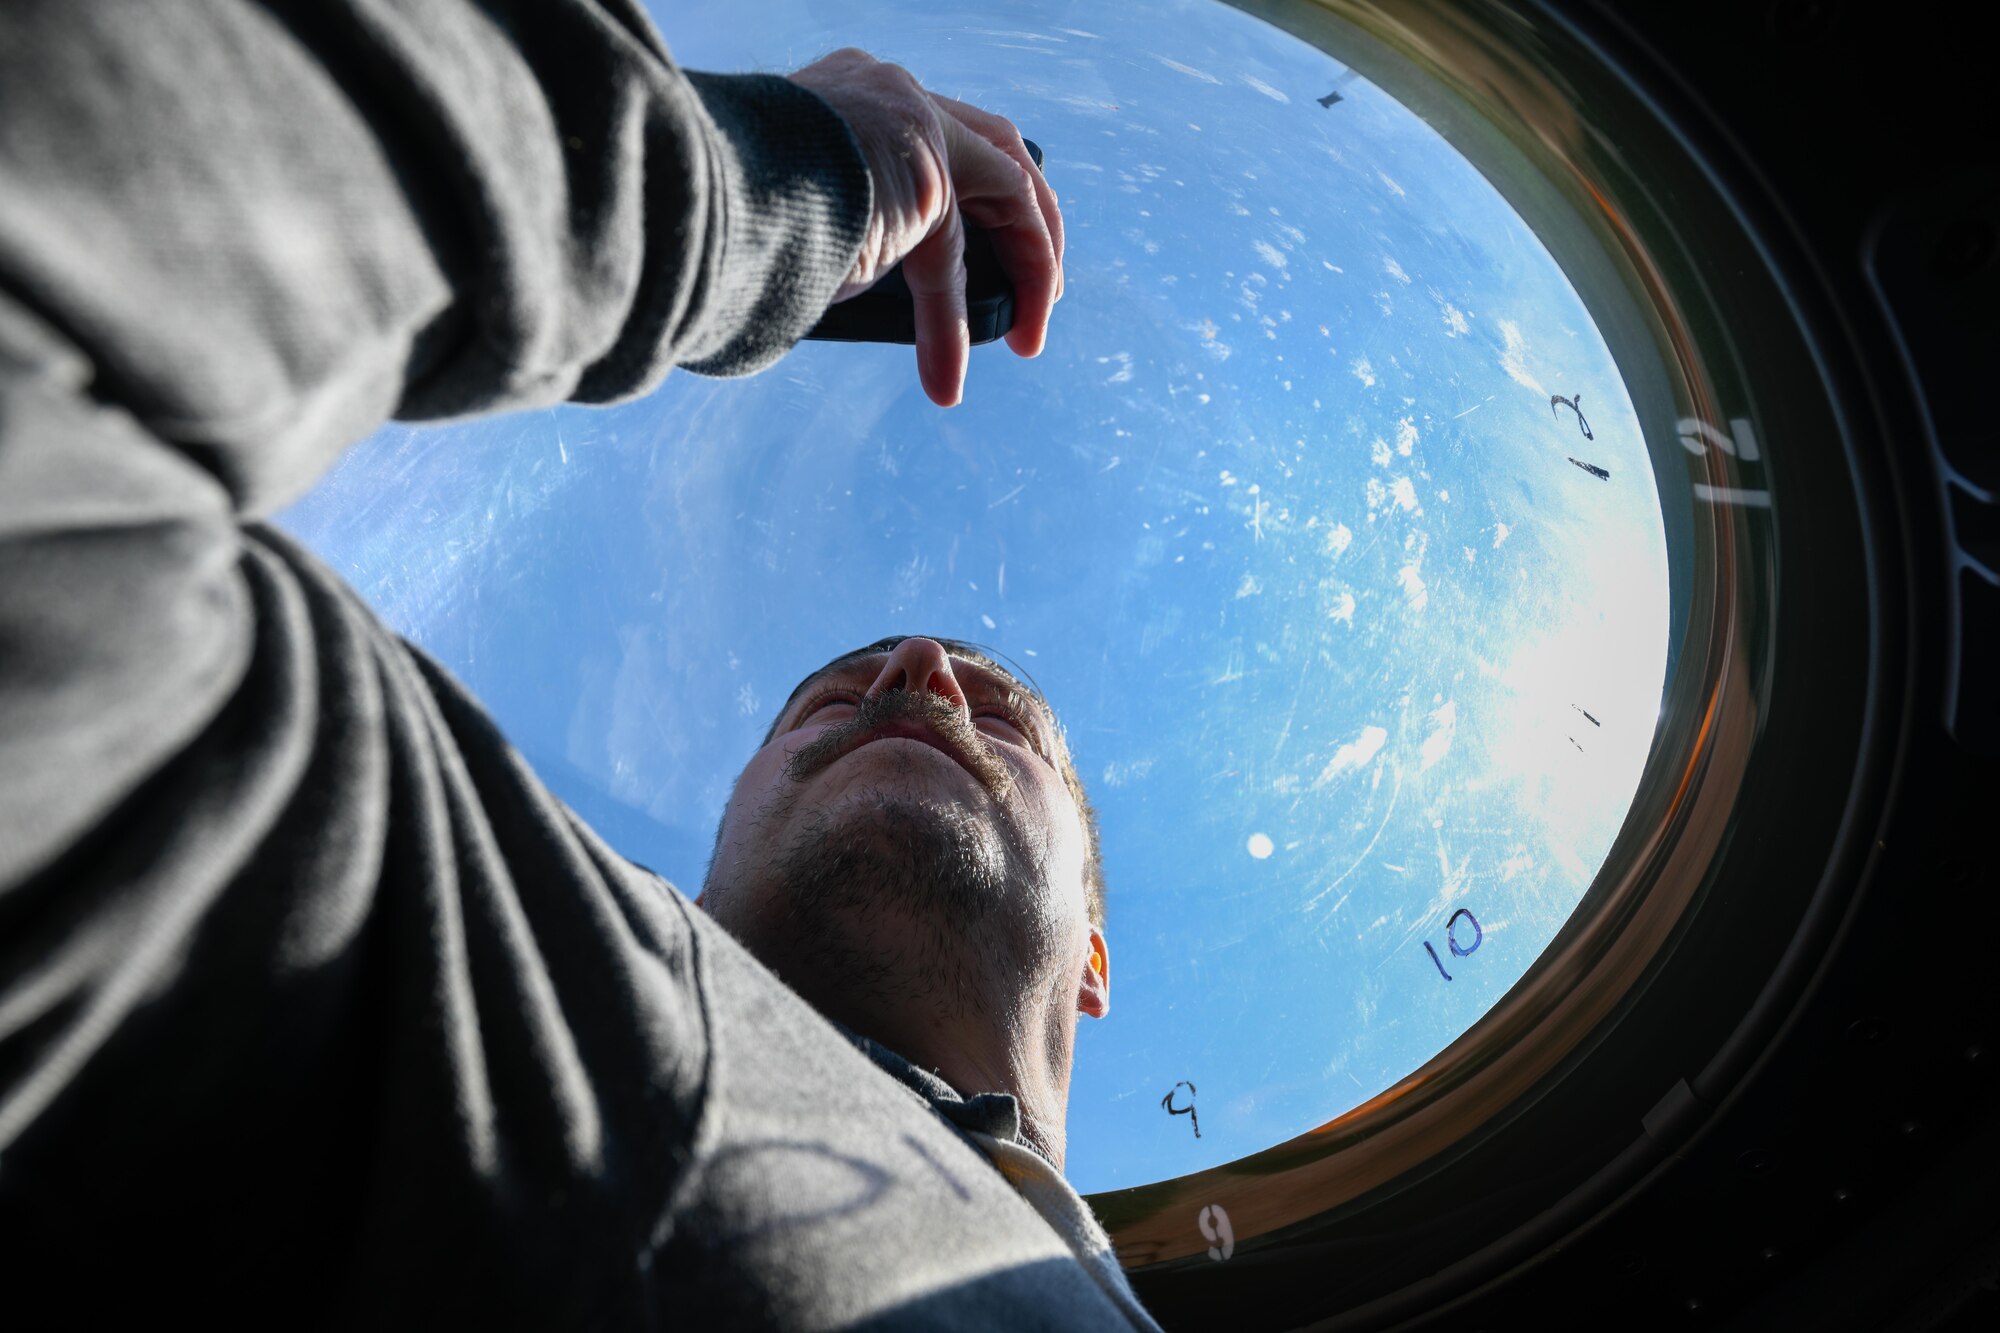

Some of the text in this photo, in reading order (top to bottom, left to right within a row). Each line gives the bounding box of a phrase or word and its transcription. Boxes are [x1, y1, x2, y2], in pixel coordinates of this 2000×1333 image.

[1551, 393, 1610, 481] 12
[1675, 418, 1770, 507] 12
[1423, 908, 1482, 981] 10
[1161, 1081, 1201, 1138] 9
[1198, 1204, 1235, 1261] 9
